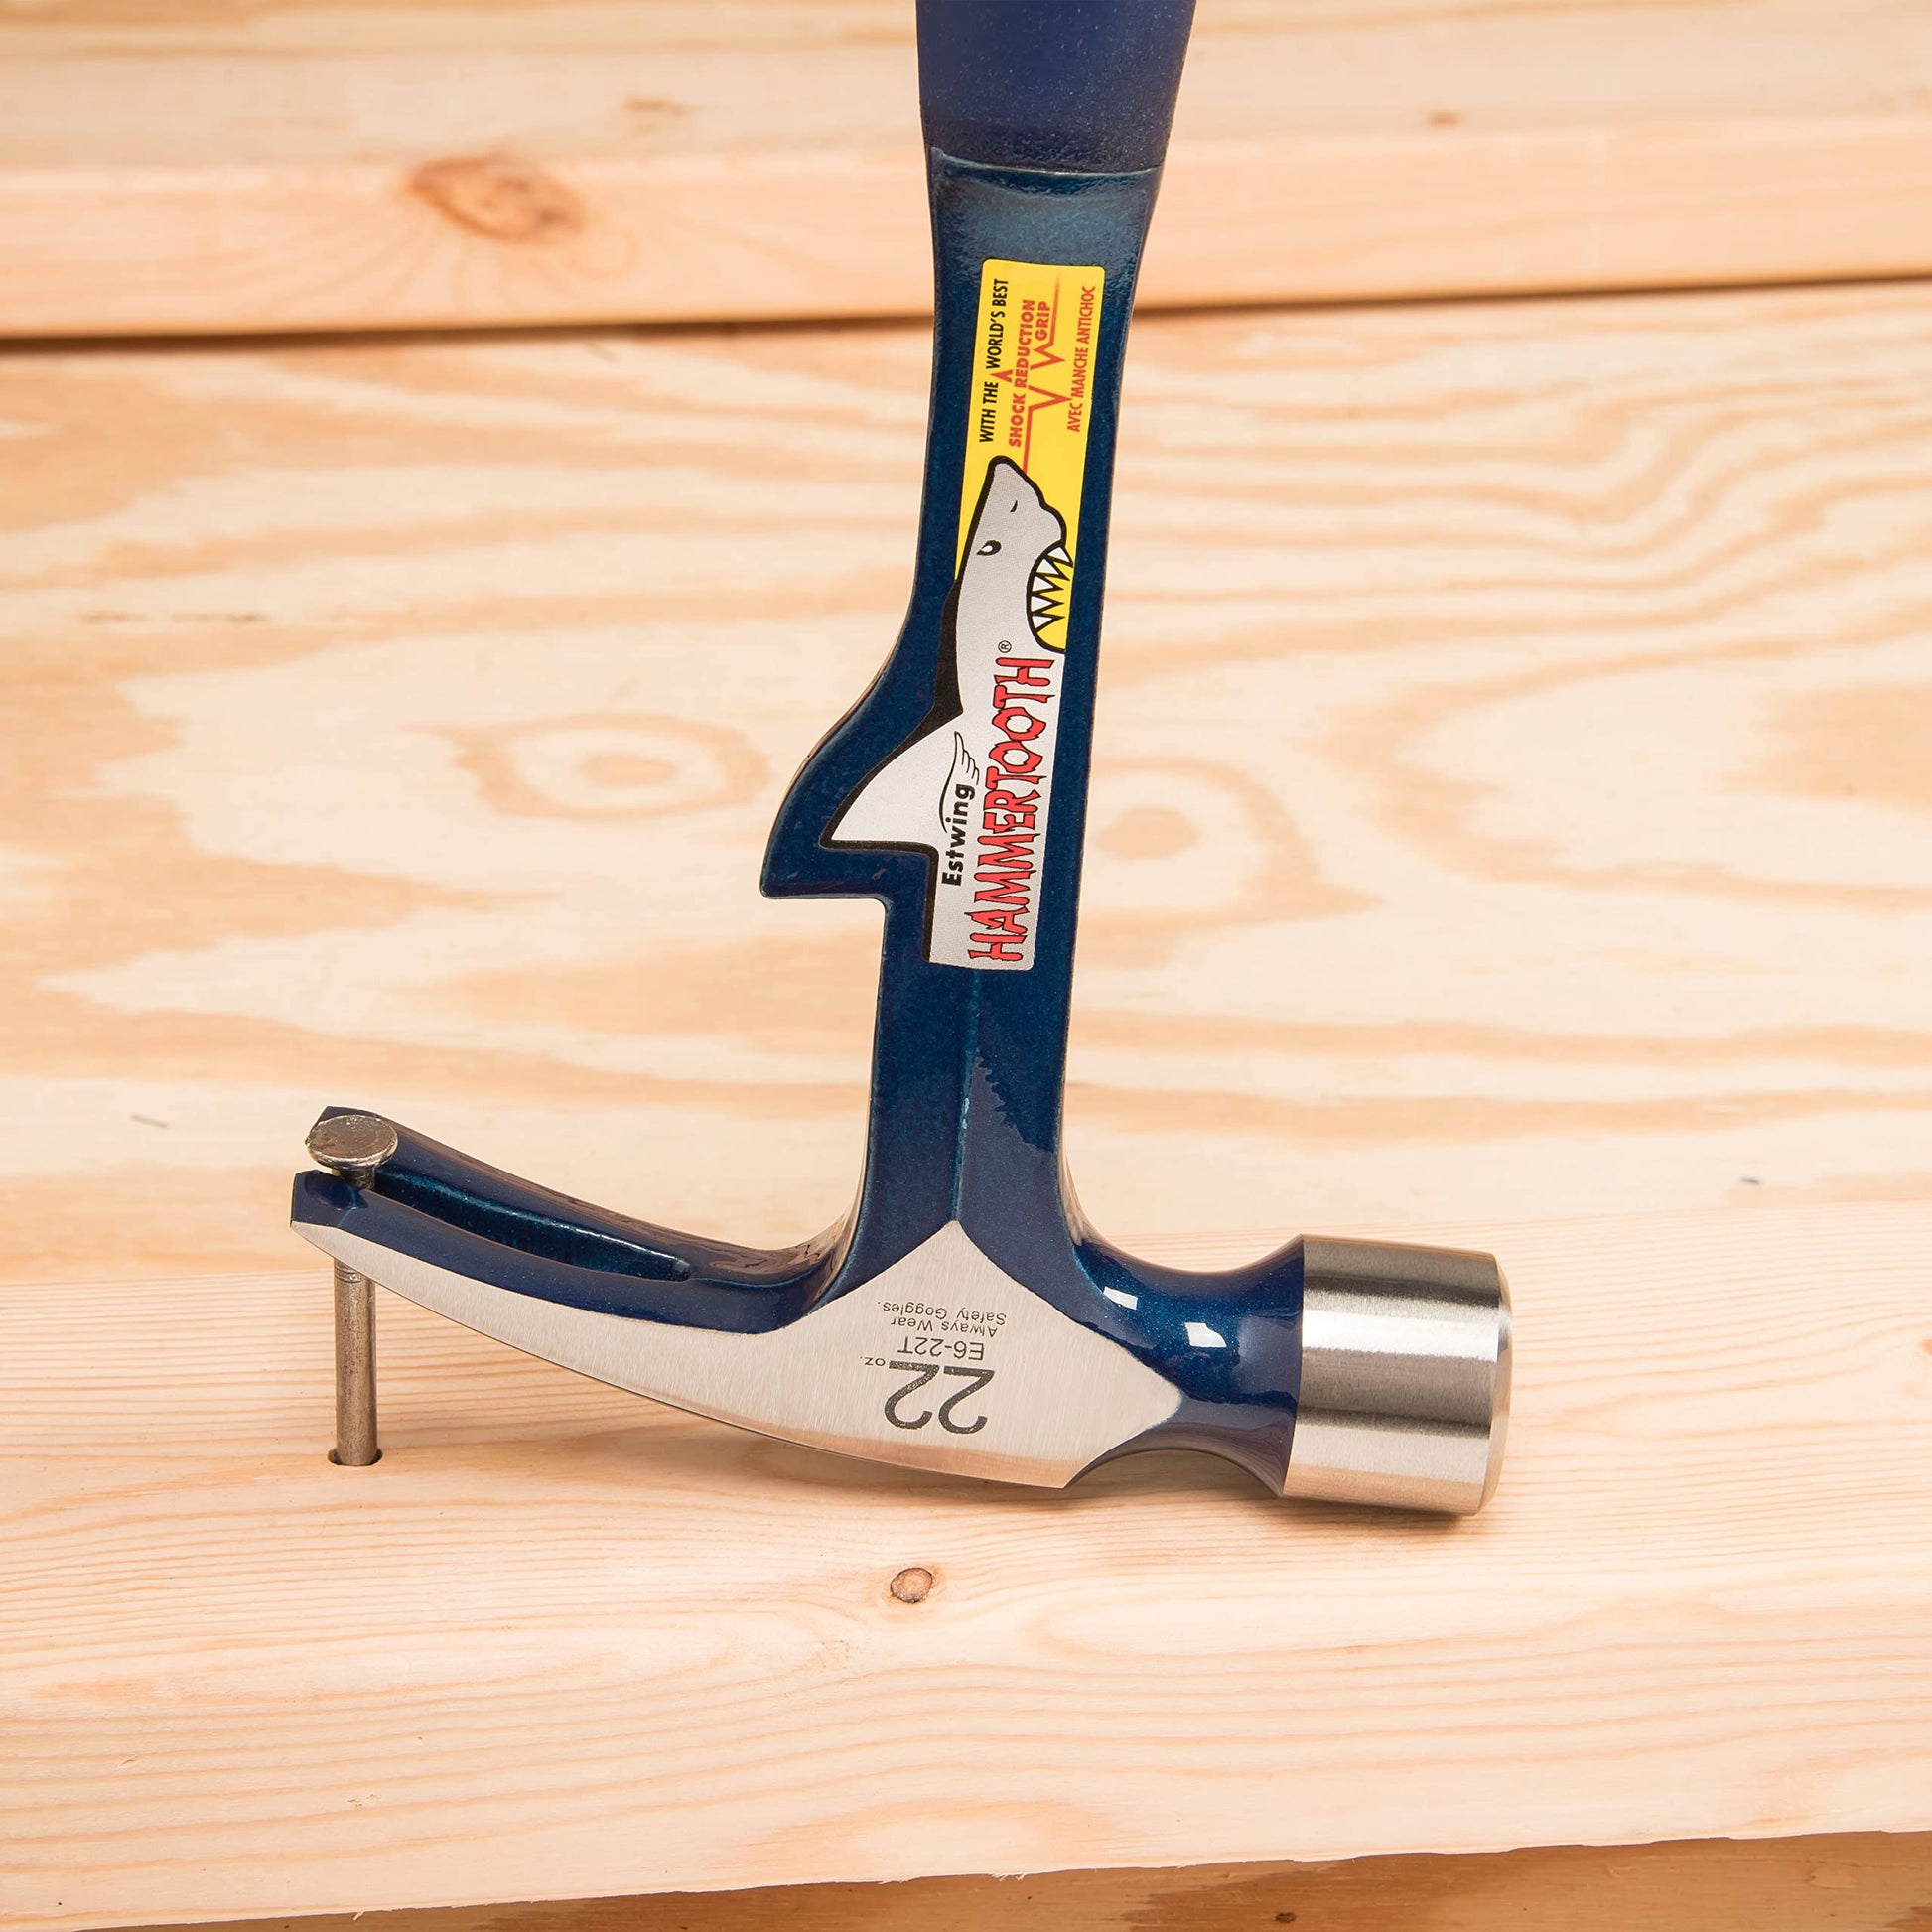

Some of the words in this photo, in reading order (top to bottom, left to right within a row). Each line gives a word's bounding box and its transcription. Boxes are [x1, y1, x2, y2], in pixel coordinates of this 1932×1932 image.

[992, 278, 1009, 307] BEST
[1035, 301, 1050, 341] GRIP
[1077, 286, 1095, 344] ANTICHOC
[986, 311, 1005, 369] WORLD'S
[1014, 299, 1035, 388] REDUCTION
[1070, 347, 1088, 398] MANCHE
[983, 381, 999, 404] THE
[979, 408, 996, 442] WITH
[1009, 393, 1026, 447] SHOCK
[1067, 402, 1083, 432] AVEC
[941, 783, 976, 886] Estwing
[878, 1302, 947, 1319] Goggles.
[891, 1317, 933, 1332] Wear
[956, 1307, 1007, 1325] Safety
[941, 1320, 998, 1338] Always
[860, 1356, 886, 1366] oz.
[897, 1335, 984, 1361] E6-22T
[884, 1360, 996, 1435] 22
